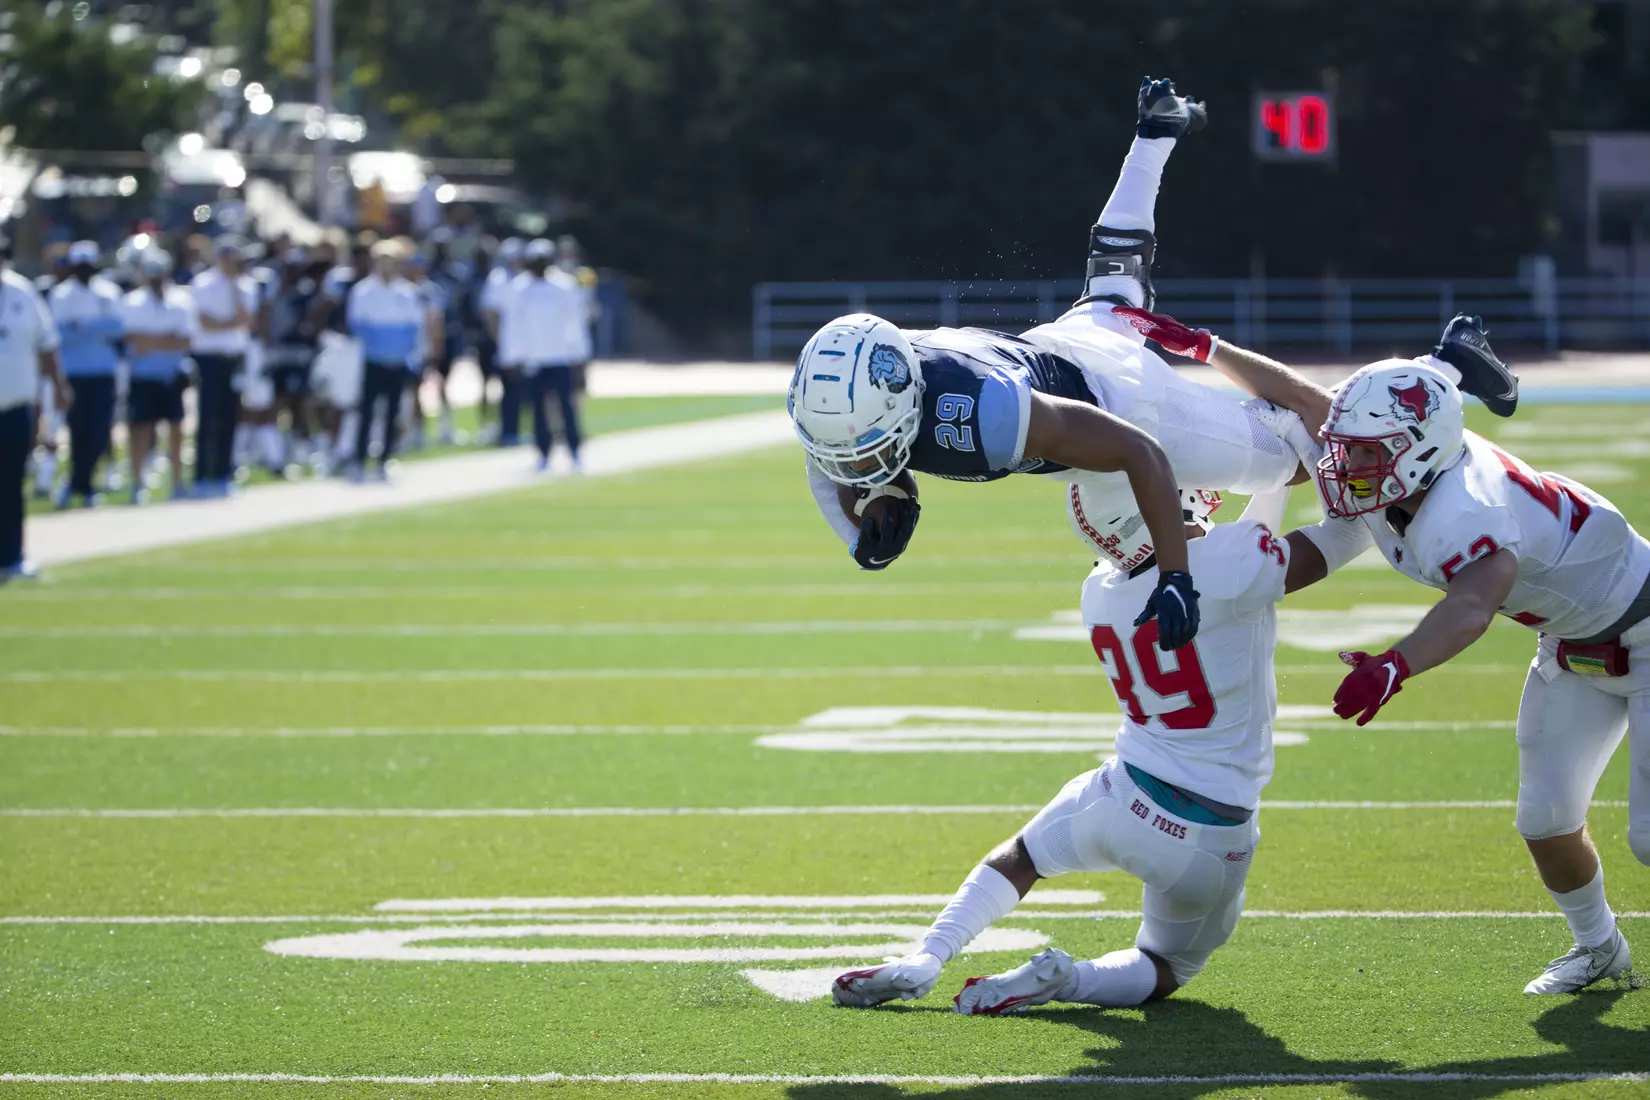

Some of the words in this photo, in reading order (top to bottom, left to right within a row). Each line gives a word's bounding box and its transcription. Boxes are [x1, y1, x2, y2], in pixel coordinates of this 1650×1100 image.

[1261, 96, 1329, 153] 40
[935, 393, 976, 451] 29
[1090, 618, 1217, 730] 39
[1130, 798, 1150, 820] RED
[1151, 814, 1188, 840] FOXES
